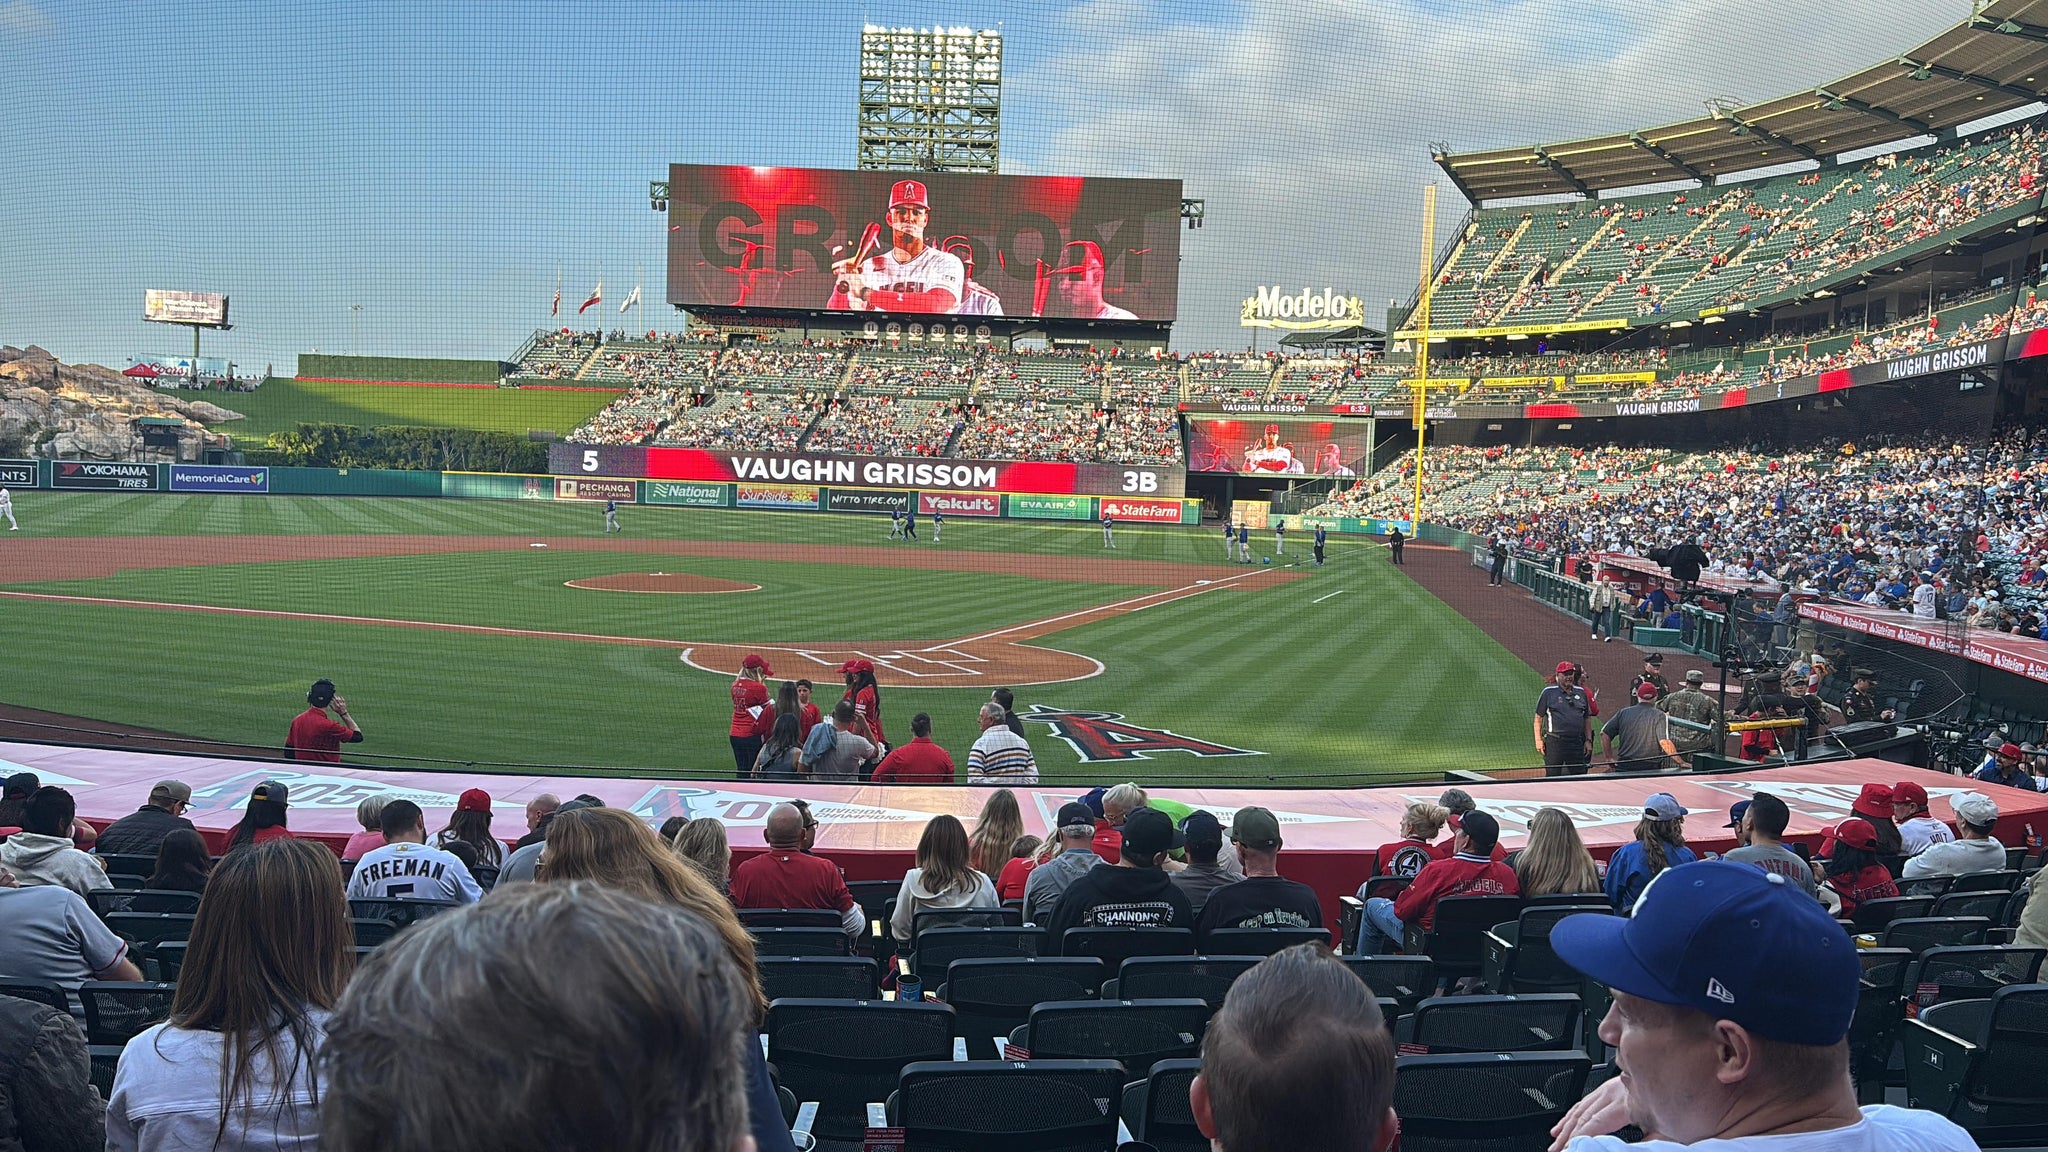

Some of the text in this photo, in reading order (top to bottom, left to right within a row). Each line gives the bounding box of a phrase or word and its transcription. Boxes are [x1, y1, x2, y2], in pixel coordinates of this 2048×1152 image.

[1257, 286, 1347, 317] Modelo
[1887, 344, 1988, 379] VAUGHN GRISSOM
[1222, 403, 1306, 413] VAUGHN GRISSOM
[1616, 399, 1700, 416] VAUGHN GRISSOM
[582, 450, 599, 472] 5
[82, 465, 148, 476] YOKOHAMA
[731, 457, 997, 488] VAUGHN GRISSOM
[118, 479, 148, 488] TIRES
[176, 473, 250, 484] MemorialCare
[1122, 471, 1158, 492] 3B
[580, 483, 631, 493] PECHANGA
[668, 485, 721, 498] National
[741, 487, 788, 502] Surfside
[831, 494, 907, 506] NITTO TIRE.COM
[925, 496, 994, 511] Yakult
[814, 813, 906, 821] CHAMPIONS
[819, 807, 886, 816] DIVISION
[361, 859, 446, 887] FREEMAN
[1097, 911, 1160, 923] SHANNON'S
[1931, 1052, 1938, 1064] H
